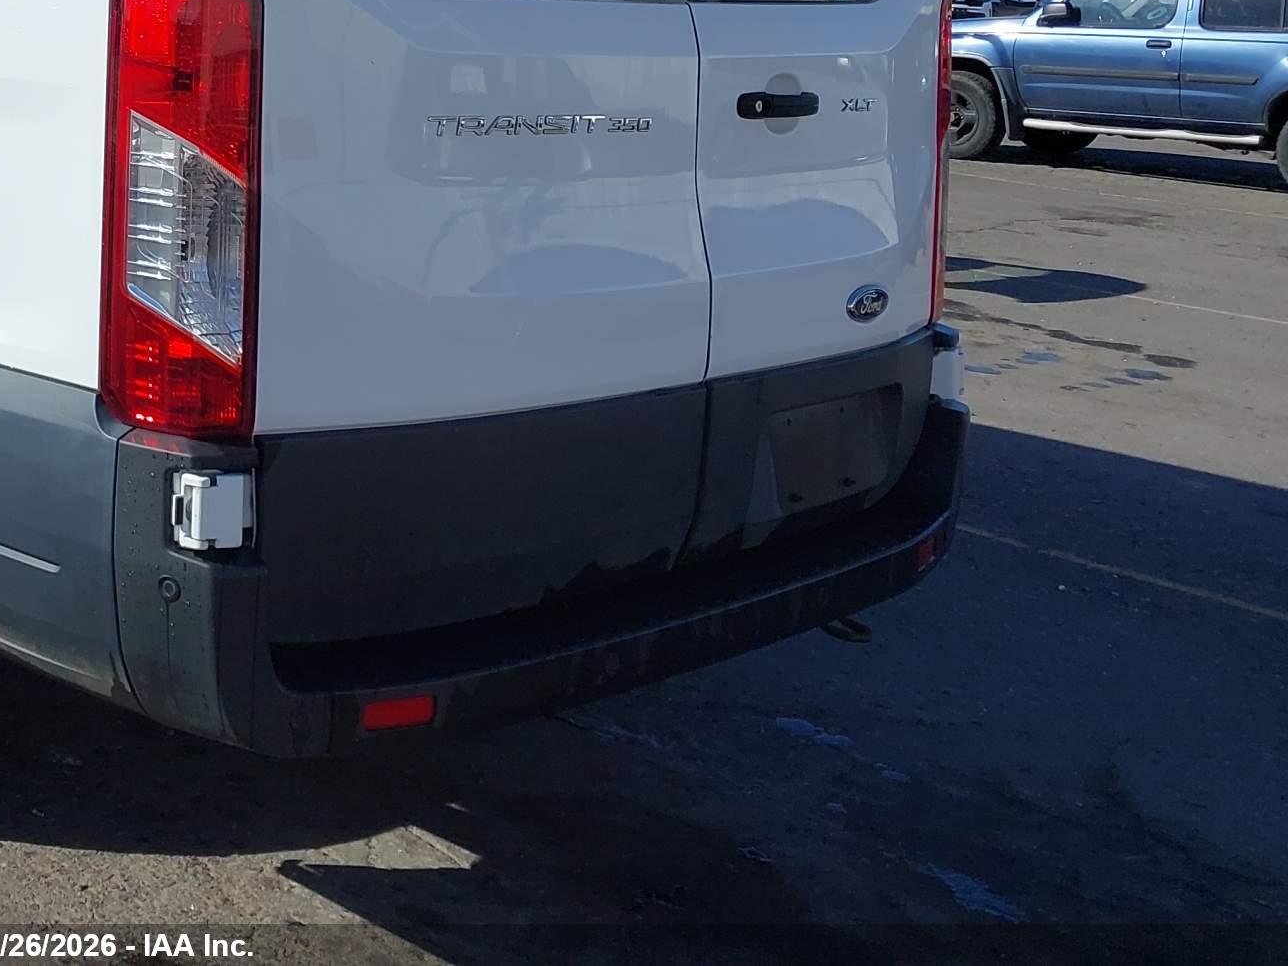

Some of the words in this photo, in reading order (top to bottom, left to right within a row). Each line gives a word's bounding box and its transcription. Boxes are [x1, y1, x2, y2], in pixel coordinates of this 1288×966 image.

[841, 98, 878, 113] XLT
[426, 114, 606, 137] TRANSIT
[607, 117, 652, 133] 350
